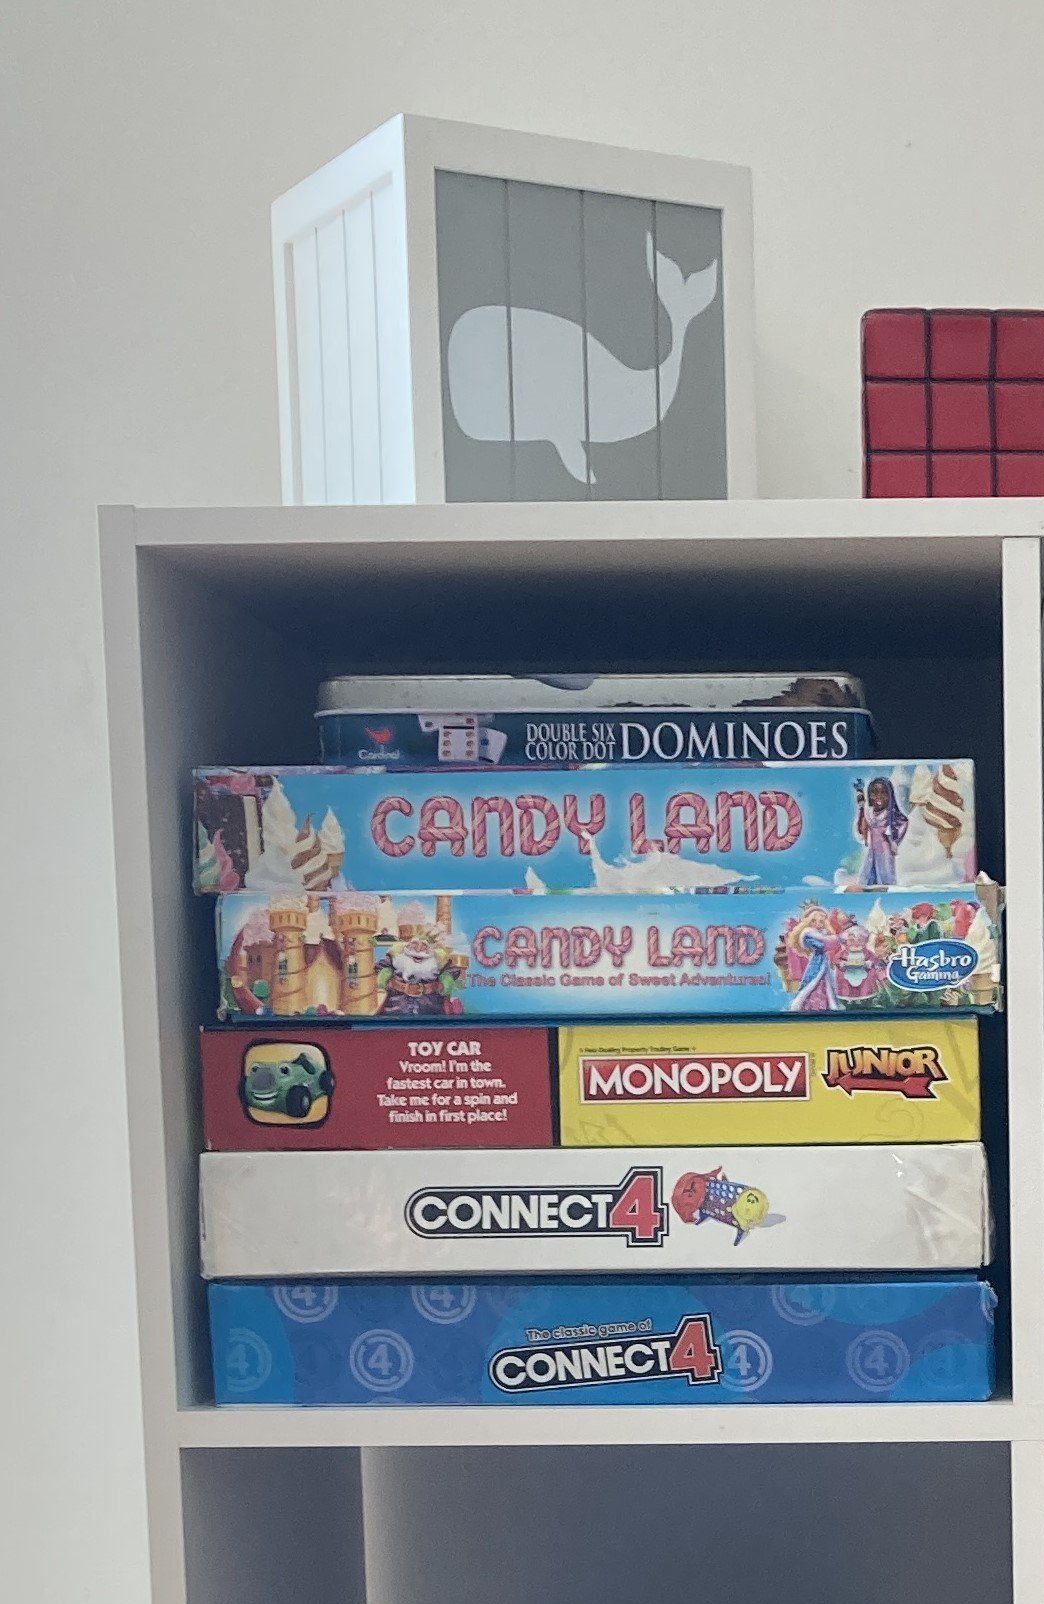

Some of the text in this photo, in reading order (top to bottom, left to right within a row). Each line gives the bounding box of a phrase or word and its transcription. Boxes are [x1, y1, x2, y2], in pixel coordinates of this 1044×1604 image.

[526, 722, 616, 742] DOUBLE SIX
[618, 720, 849, 761] DOMINOES
[525, 741, 616, 761] COLOR DOT
[370, 790, 803, 857] CANDY LAND
[472, 923, 767, 970] CANDY LAND
[892, 947, 973, 971] Hasbro
[467, 974, 496, 987] The
[501, 973, 556, 988] Classic
[559, 973, 604, 987] Game
[608, 972, 623, 987] of
[629, 972, 676, 987] Sweet
[906, 966, 960, 985] Gaming
[408, 1041, 482, 1056] TOY CAR
[399, 1059, 492, 1073] Vroom! I'm the
[827, 1047, 946, 1087] JUNIOR
[386, 1076, 506, 1090] fastest car in town.
[588, 1060, 803, 1097] MONOPOLY
[377, 1092, 518, 1107] Take me for a spin and
[389, 1108, 508, 1125] finish in first place!
[413, 1172, 662, 1240] CONNECT 4
[527, 1318, 653, 1341] The classic game of
[368, 1344, 393, 1376] 4
[495, 1320, 715, 1385] CONNECT 4
[729, 1344, 752, 1377] 4
